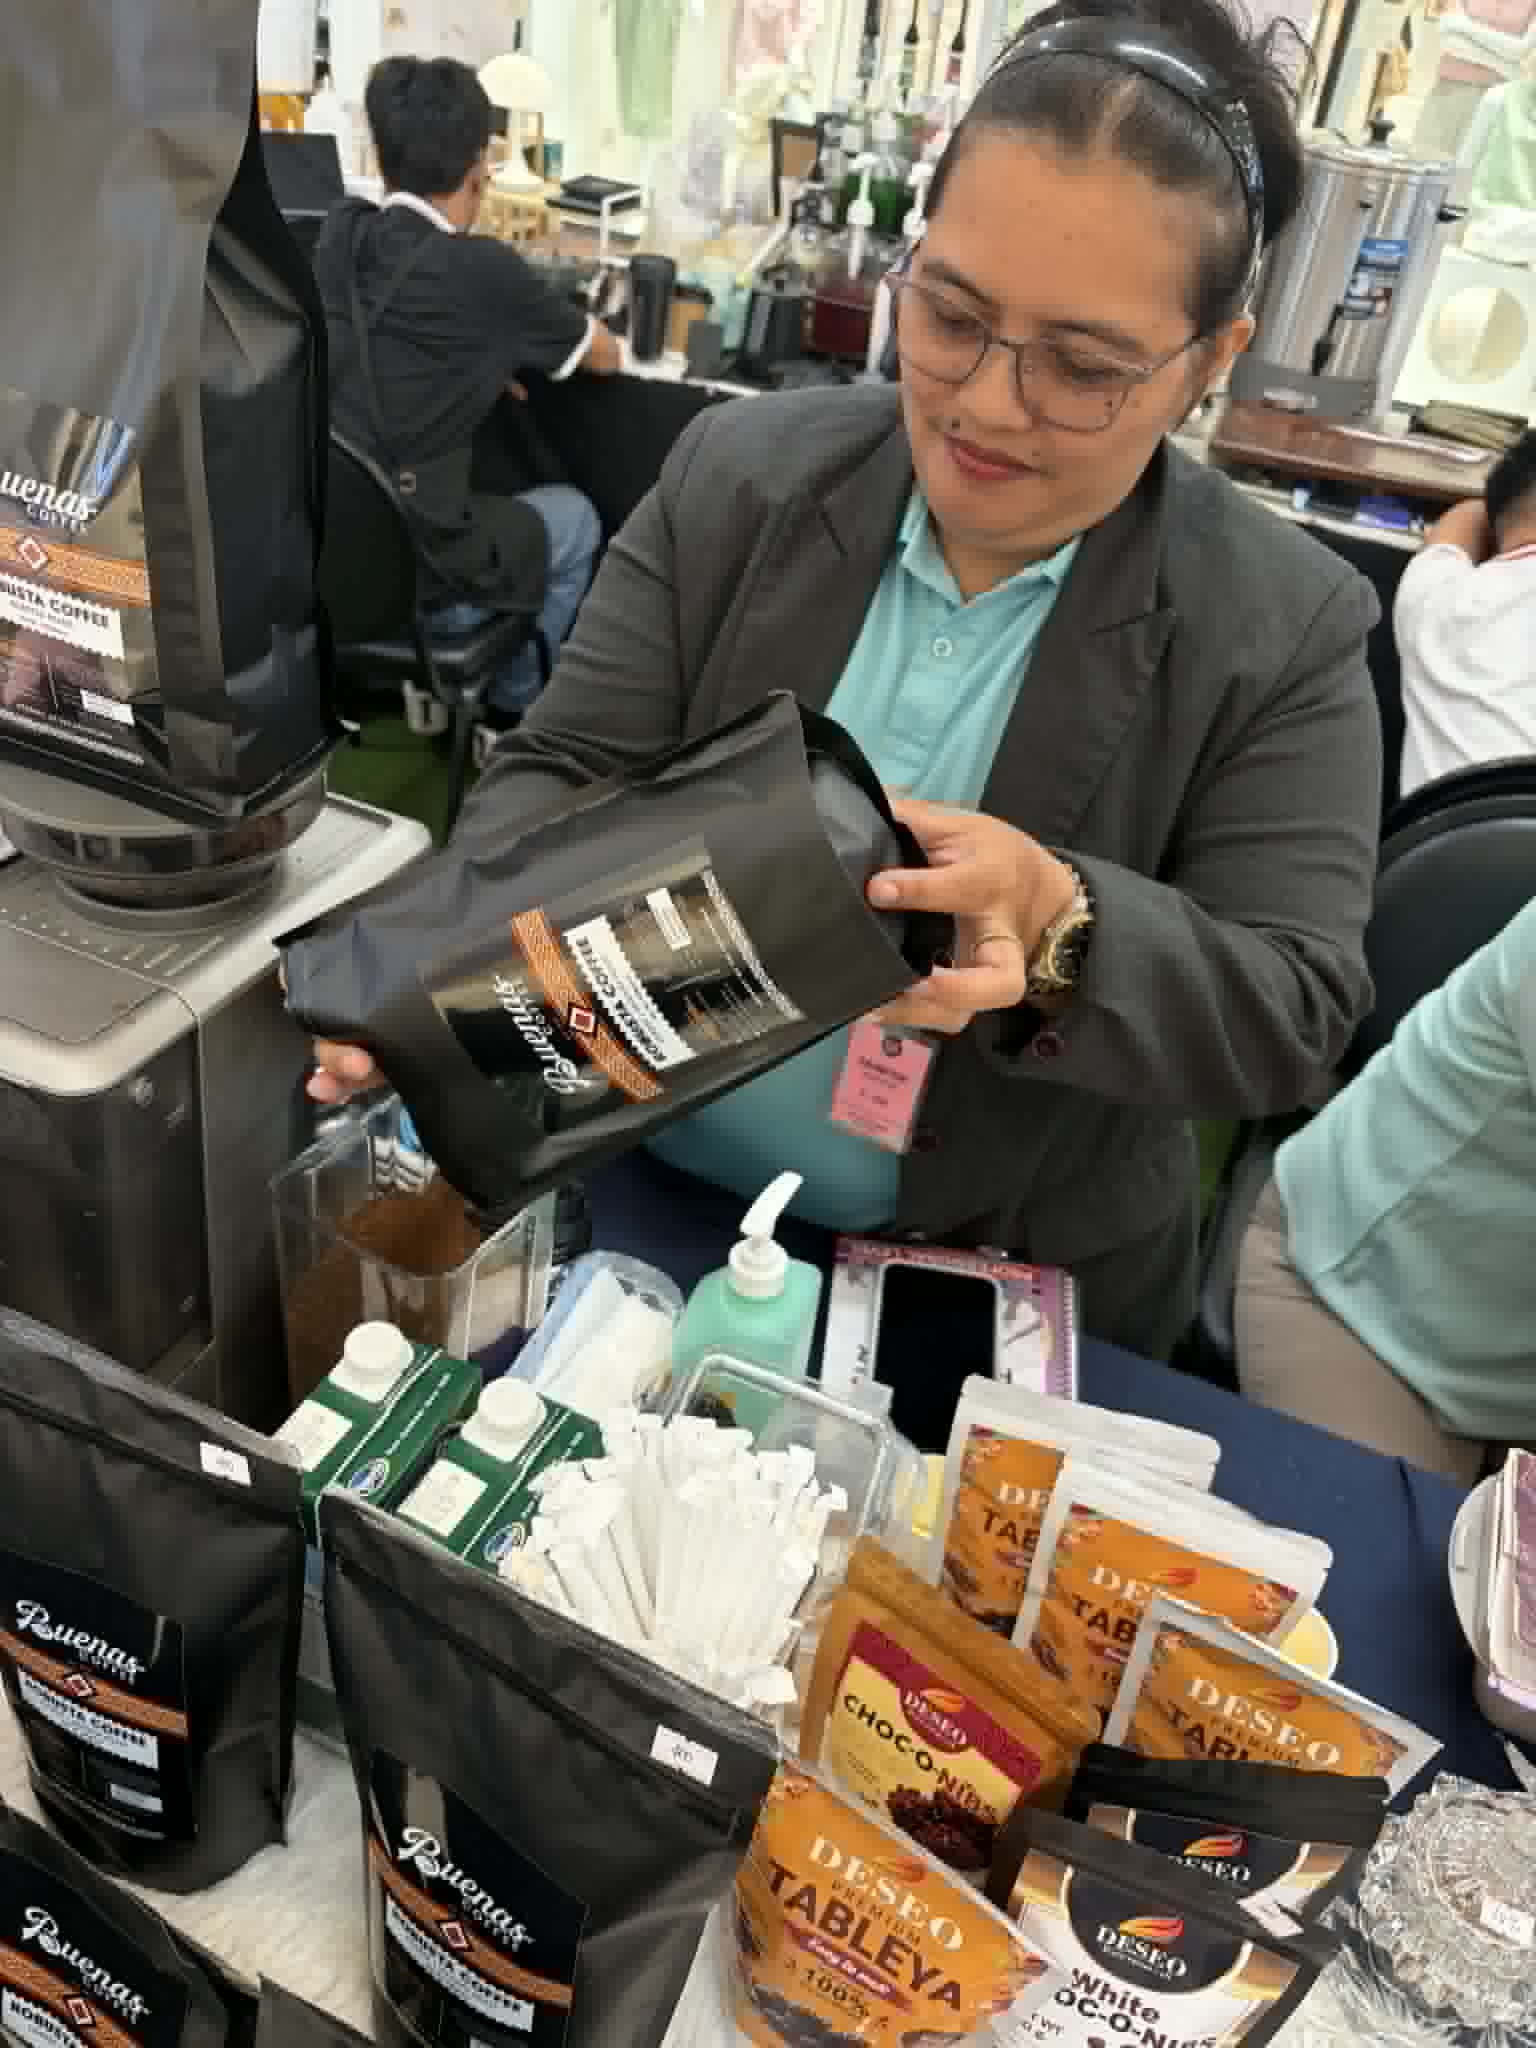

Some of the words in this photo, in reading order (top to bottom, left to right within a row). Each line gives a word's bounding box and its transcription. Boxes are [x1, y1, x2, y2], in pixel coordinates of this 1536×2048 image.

[0, 471, 97, 519] uenas
[49, 597, 110, 630] COFFEE
[573, 934, 617, 998] COFFEE
[611, 1001, 667, 1063] ROBUSTA
[998, 1482, 1050, 1509] DE
[981, 1508, 1041, 1550] TAB
[1092, 1562, 1152, 1601] DE
[15, 1599, 149, 1674] Buenas
[1071, 1591, 1138, 1643] TAB
[24, 1676, 93, 1724] ROBUSTA
[90, 1713, 151, 1748] COFFEE
[903, 1690, 968, 1746] DESEO
[1166, 1700, 1250, 1760] TAB
[1188, 1676, 1341, 1764] DESEO
[842, 1692, 996, 1824] CHOC-O-NIBS
[398, 1826, 537, 1941] Buenas
[808, 1834, 964, 1951] DESEO
[1168, 1853, 1251, 1883] ESEO
[767, 1857, 962, 2012] TABLEYA
[831, 1879, 921, 1947] PREMIUM
[21, 1905, 152, 2016] Buenas
[390, 1905, 456, 1970] ROBUSTA
[457, 1964, 522, 2013] COFFEE
[1096, 1923, 1188, 1978] DESEO
[806, 1967, 871, 2018] 100%
[1071, 1967, 1161, 2024] White
